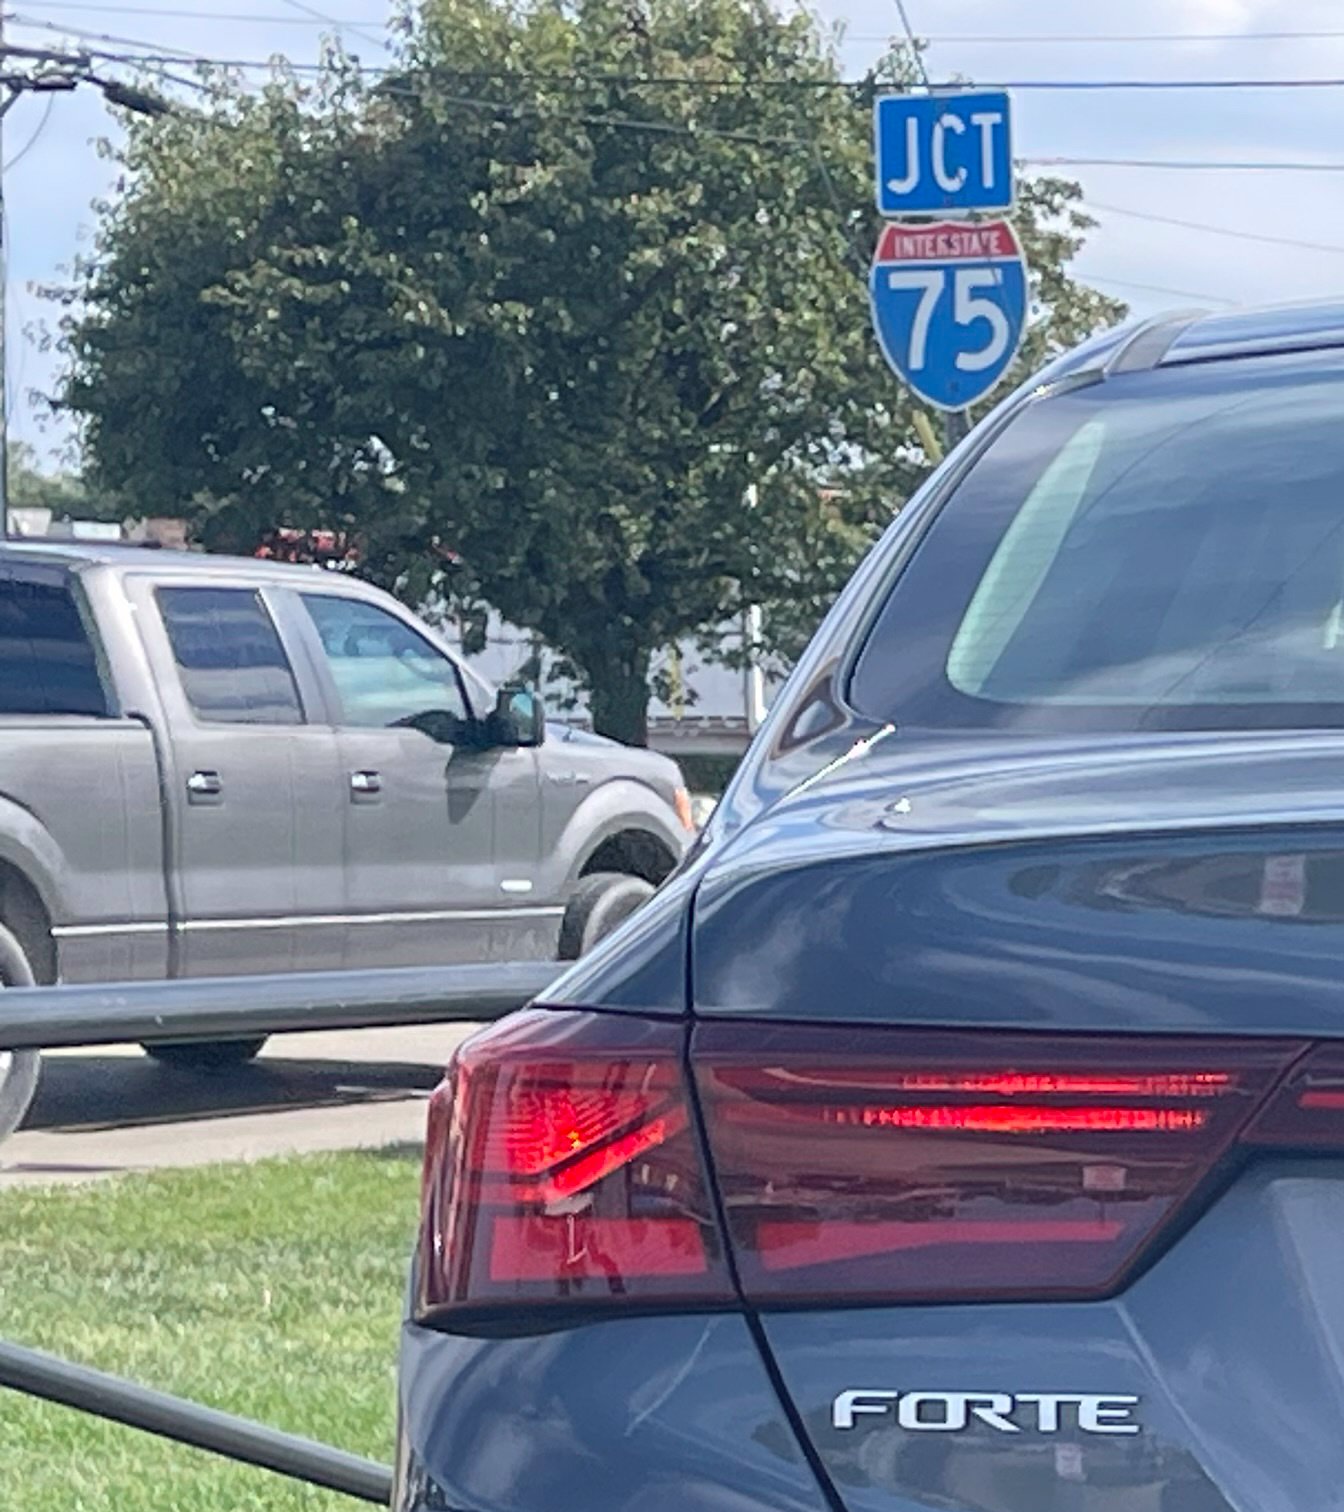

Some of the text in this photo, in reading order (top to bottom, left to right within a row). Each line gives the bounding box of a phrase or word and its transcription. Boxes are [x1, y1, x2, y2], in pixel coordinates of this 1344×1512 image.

[887, 112, 1002, 195] JCT
[894, 230, 1001, 259] INTERSTATE
[888, 269, 1009, 371] 75
[833, 1389, 1140, 1433] FORTE
